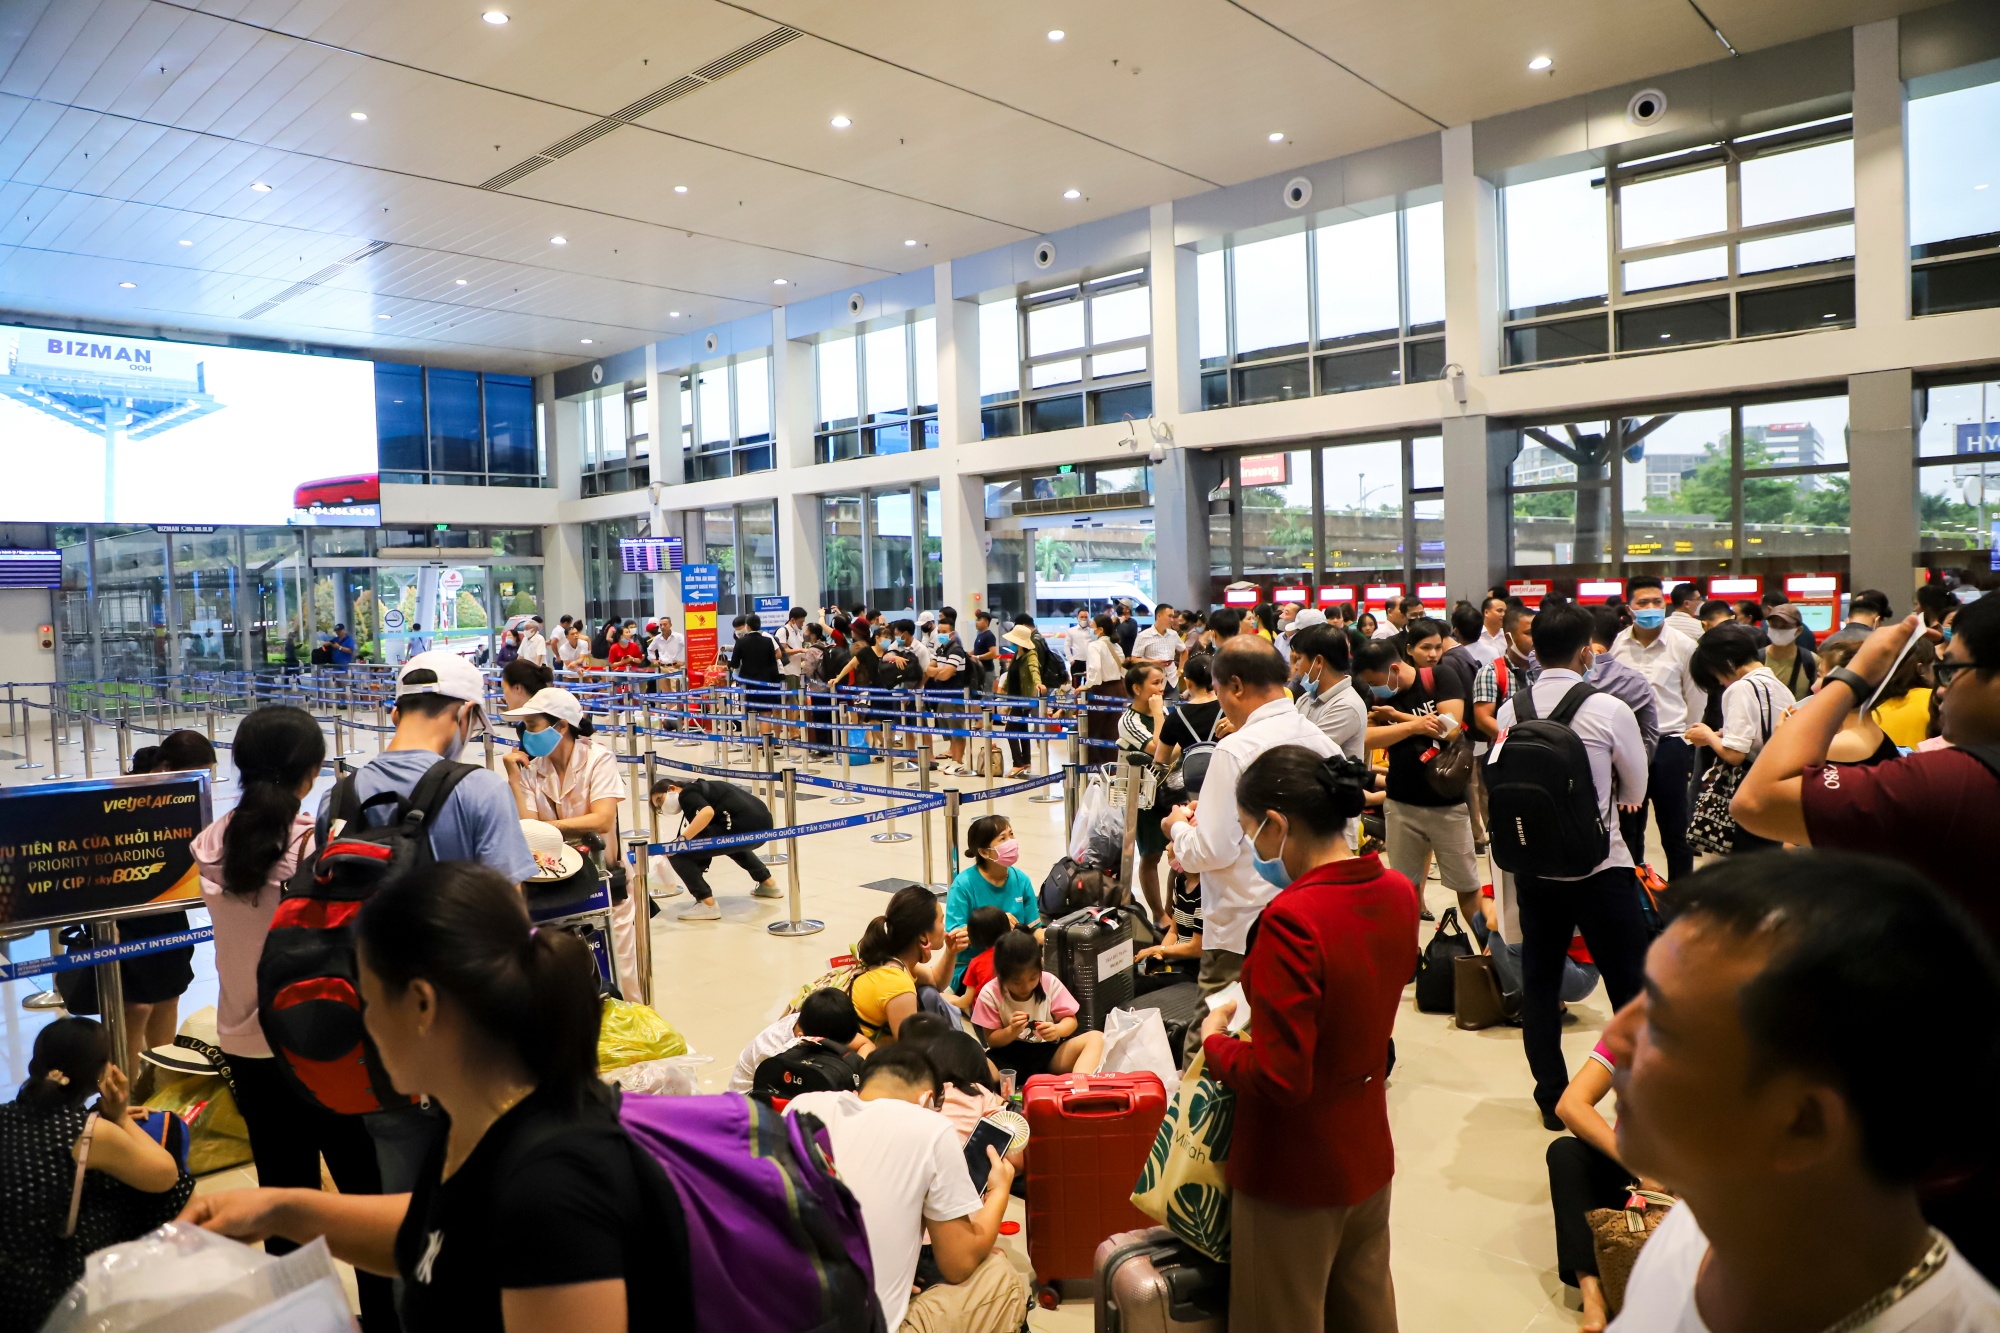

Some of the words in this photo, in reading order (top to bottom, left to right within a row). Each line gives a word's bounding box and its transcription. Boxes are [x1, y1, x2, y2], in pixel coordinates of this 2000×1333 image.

[48, 338, 151, 364] BIZMAN
[130, 364, 152, 372] OOH
[831, 781, 844, 789] TIA
[1024, 782, 1035, 790] KHÔNG
[887, 789, 916, 798] INTERNATIONAL
[972, 792, 988, 800] TIA
[104, 794, 196, 813] VietjetAir.com
[907, 805, 917, 813] TAN
[918, 803, 928, 811] SON
[930, 800, 942, 808] NHAT
[864, 812, 885, 822] TIA
[736, 834, 754, 843] HÀNG
[755, 831, 777, 840] KHÔNG
[797, 826, 804, 834] TẾ
[819, 822, 831, 830] SƠN
[832, 820, 847, 828] NHẤT
[1516, 816, 1526, 845] SAMSUNG
[21, 839, 52, 856] TIÊN
[58, 840, 77, 852] RA
[82, 834, 110, 850] CỬA
[115, 828, 148, 846] KHỞI
[153, 826, 192, 842] HÀNH
[662, 842, 688, 852] TIA
[28, 855, 89, 874] PRIORITY
[95, 847, 165, 866] BOARDING
[28, 880, 52, 894] VIP
[62, 876, 85, 890] CIP
[94, 864, 153, 886] skyBOSS
[70, 954, 91, 964] TAN
[94, 949, 116, 959] SON
[119, 943, 146, 954] NHAT
[793, 1075, 802, 1085] LG
